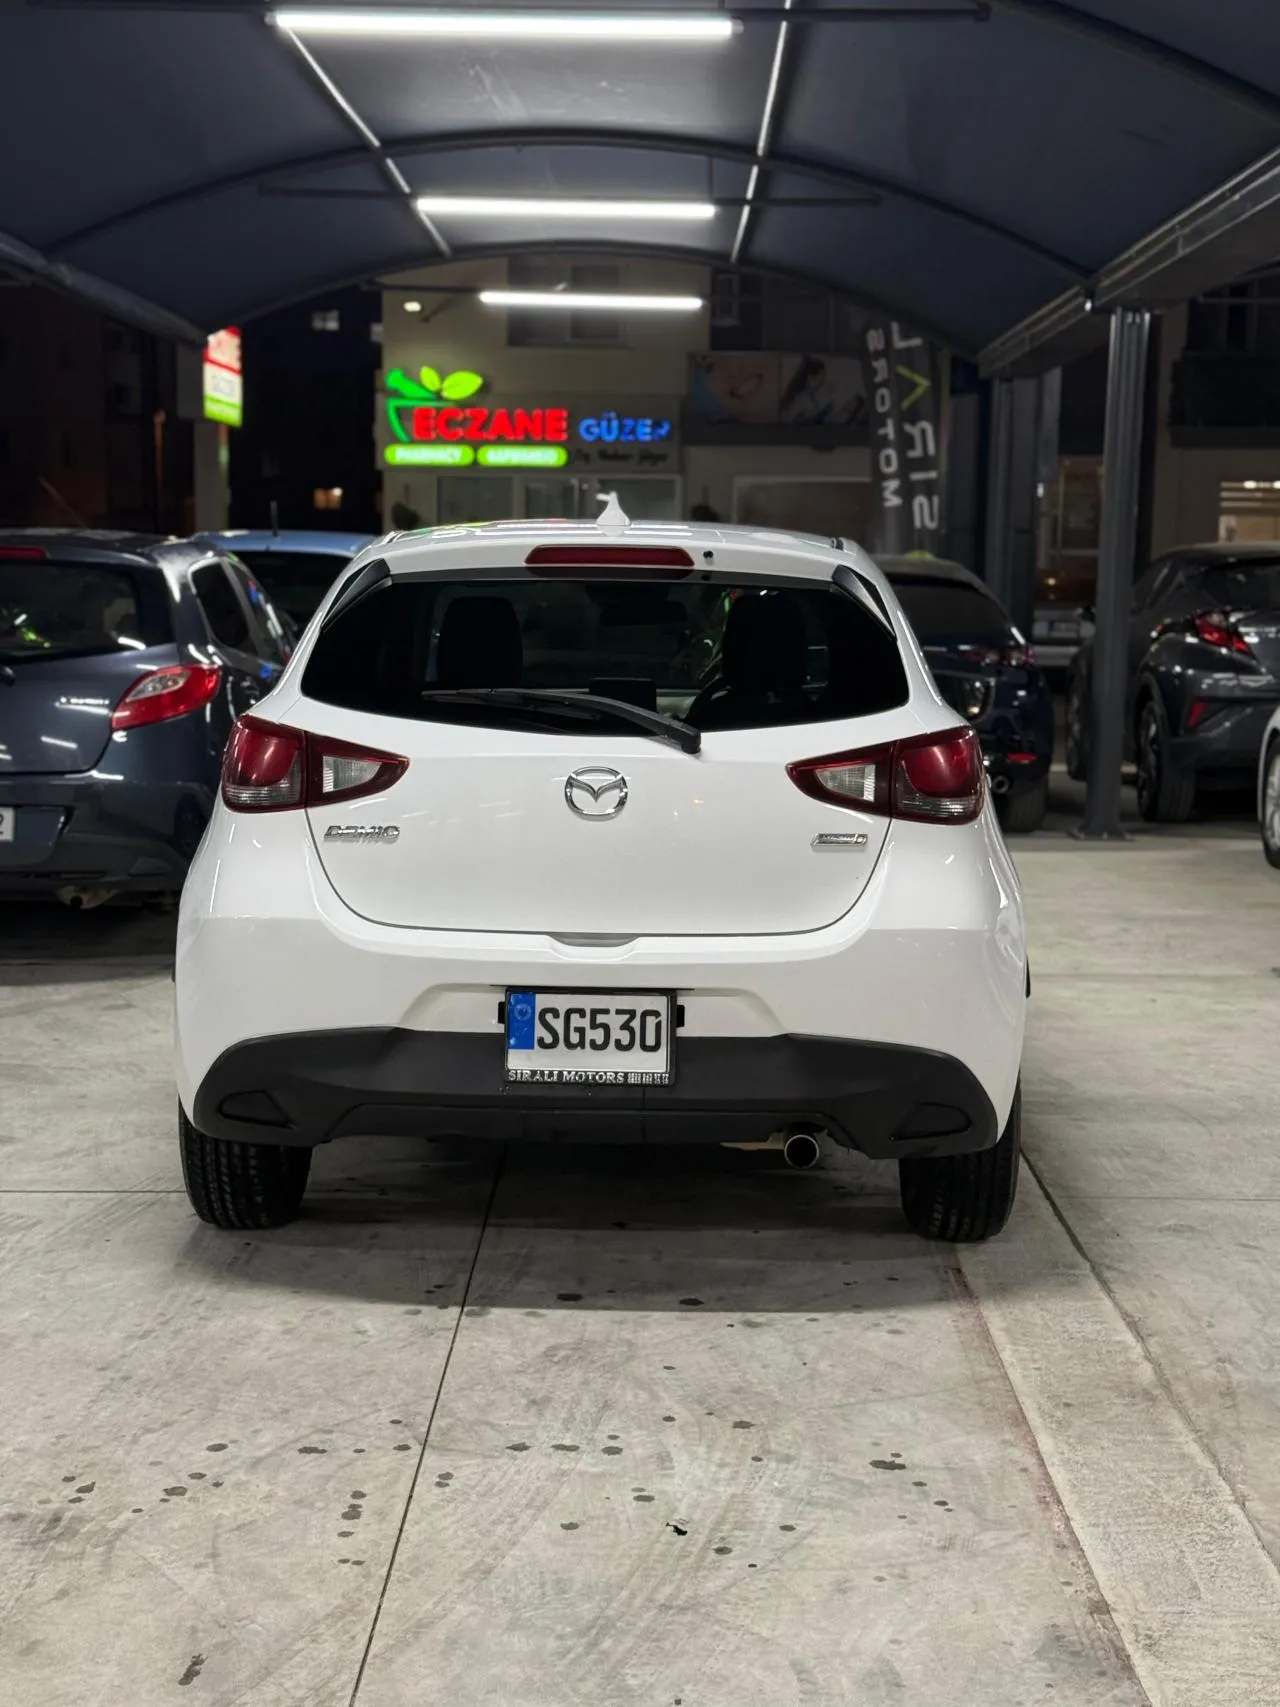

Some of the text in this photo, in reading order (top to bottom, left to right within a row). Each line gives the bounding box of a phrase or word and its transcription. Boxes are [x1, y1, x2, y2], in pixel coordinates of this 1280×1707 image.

[412, 407, 569, 441] ECZANE
[324, 824, 400, 842] DEMIO
[537, 1007, 662, 1053] SG530
[562, 1071, 625, 1084] MOTORS
